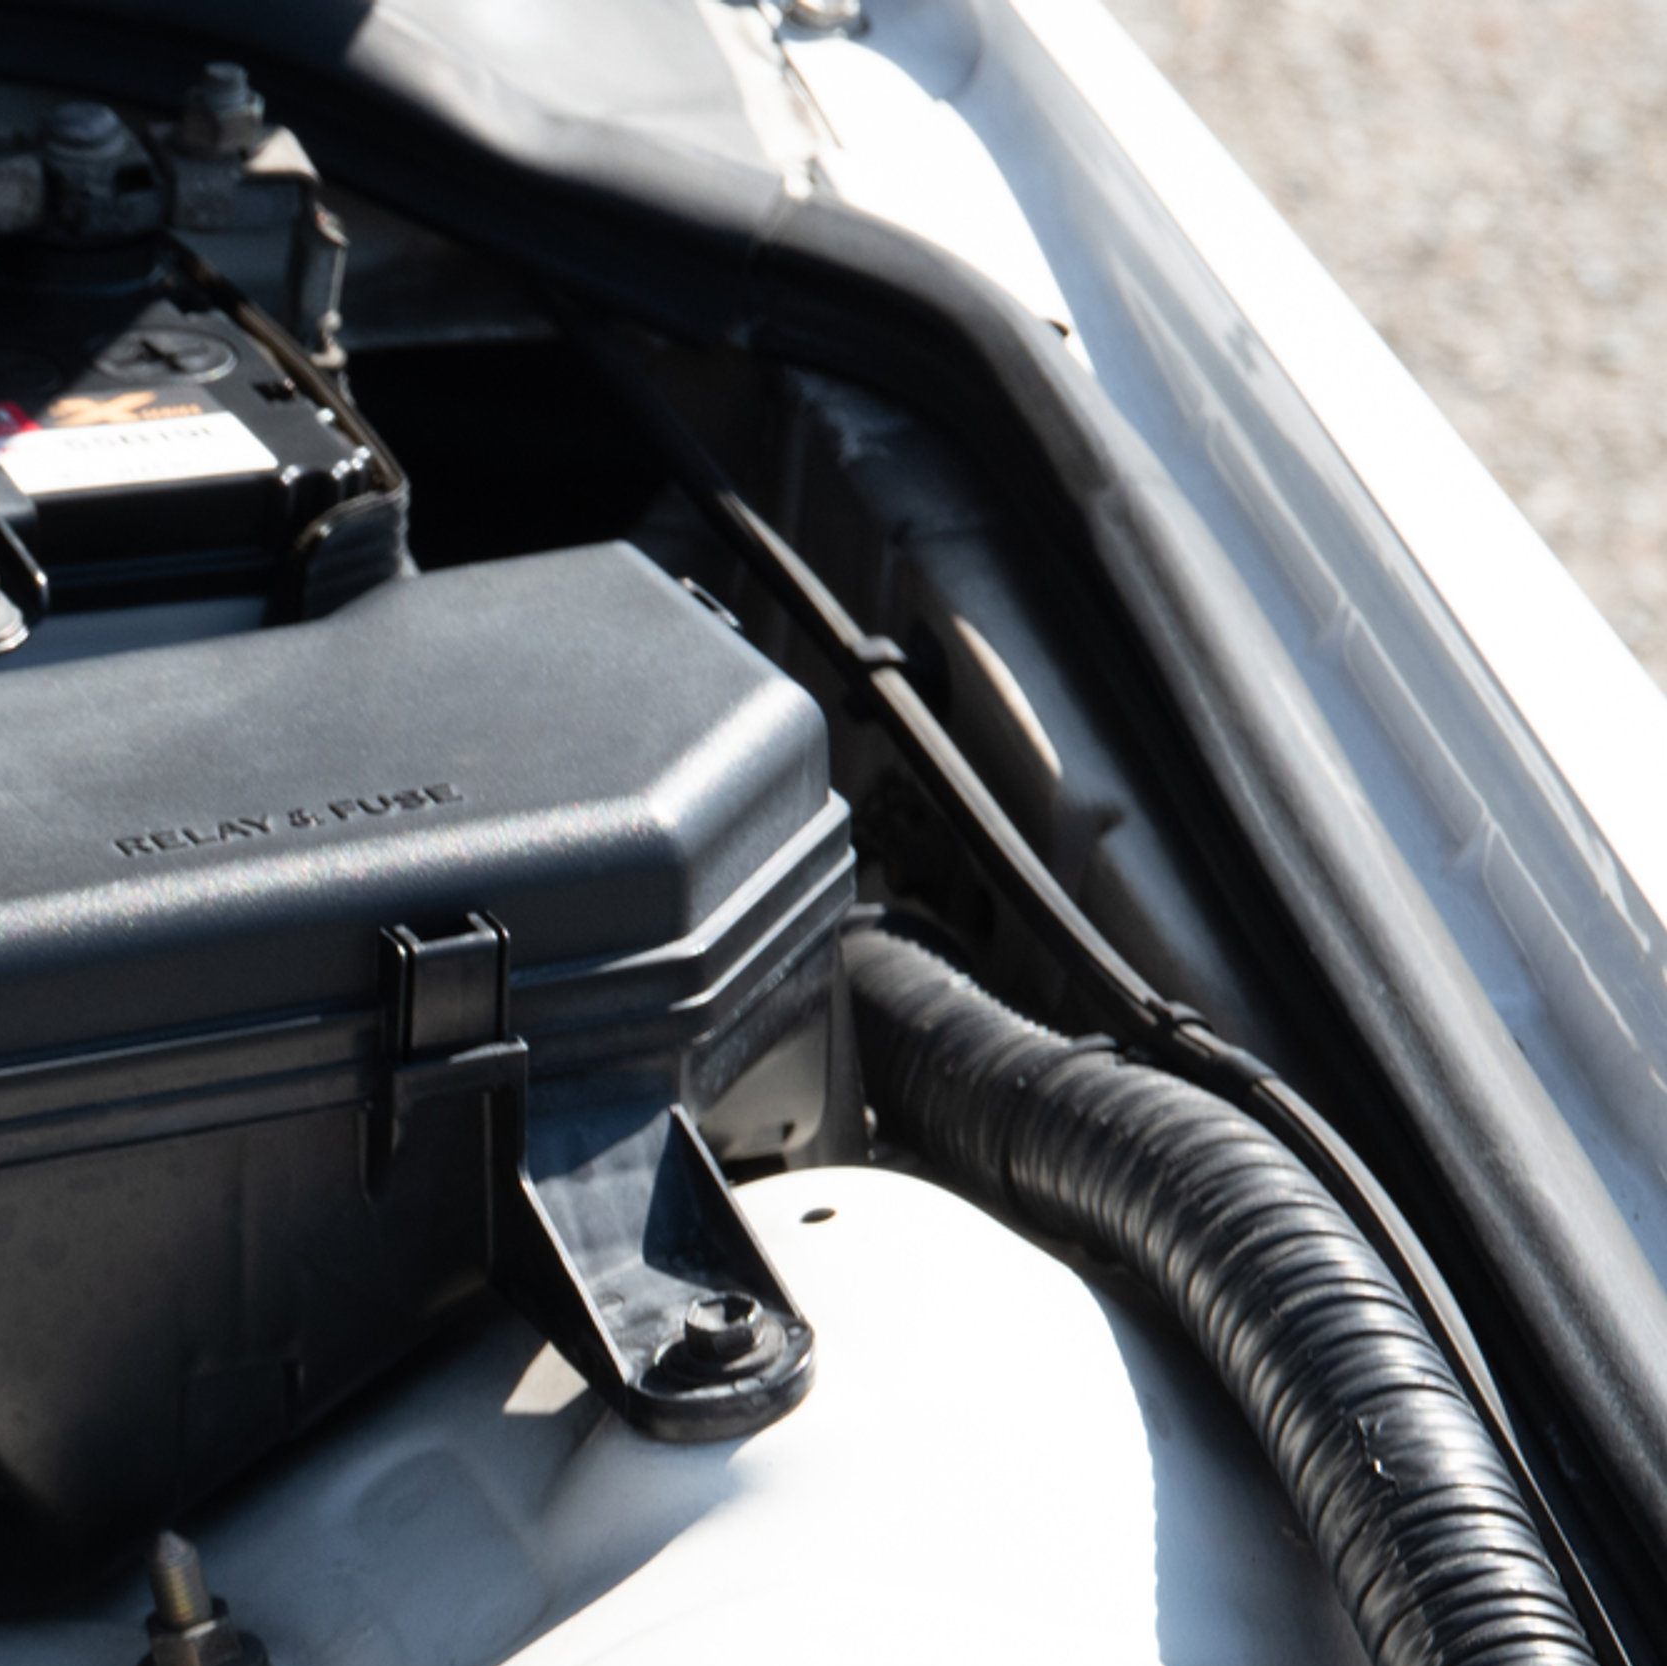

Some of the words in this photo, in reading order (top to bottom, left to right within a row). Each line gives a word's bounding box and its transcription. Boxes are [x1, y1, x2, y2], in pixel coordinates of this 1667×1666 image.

[115, 814, 272, 858] RELAY
[287, 808, 324, 828] &
[327, 782, 463, 822] FUSE
